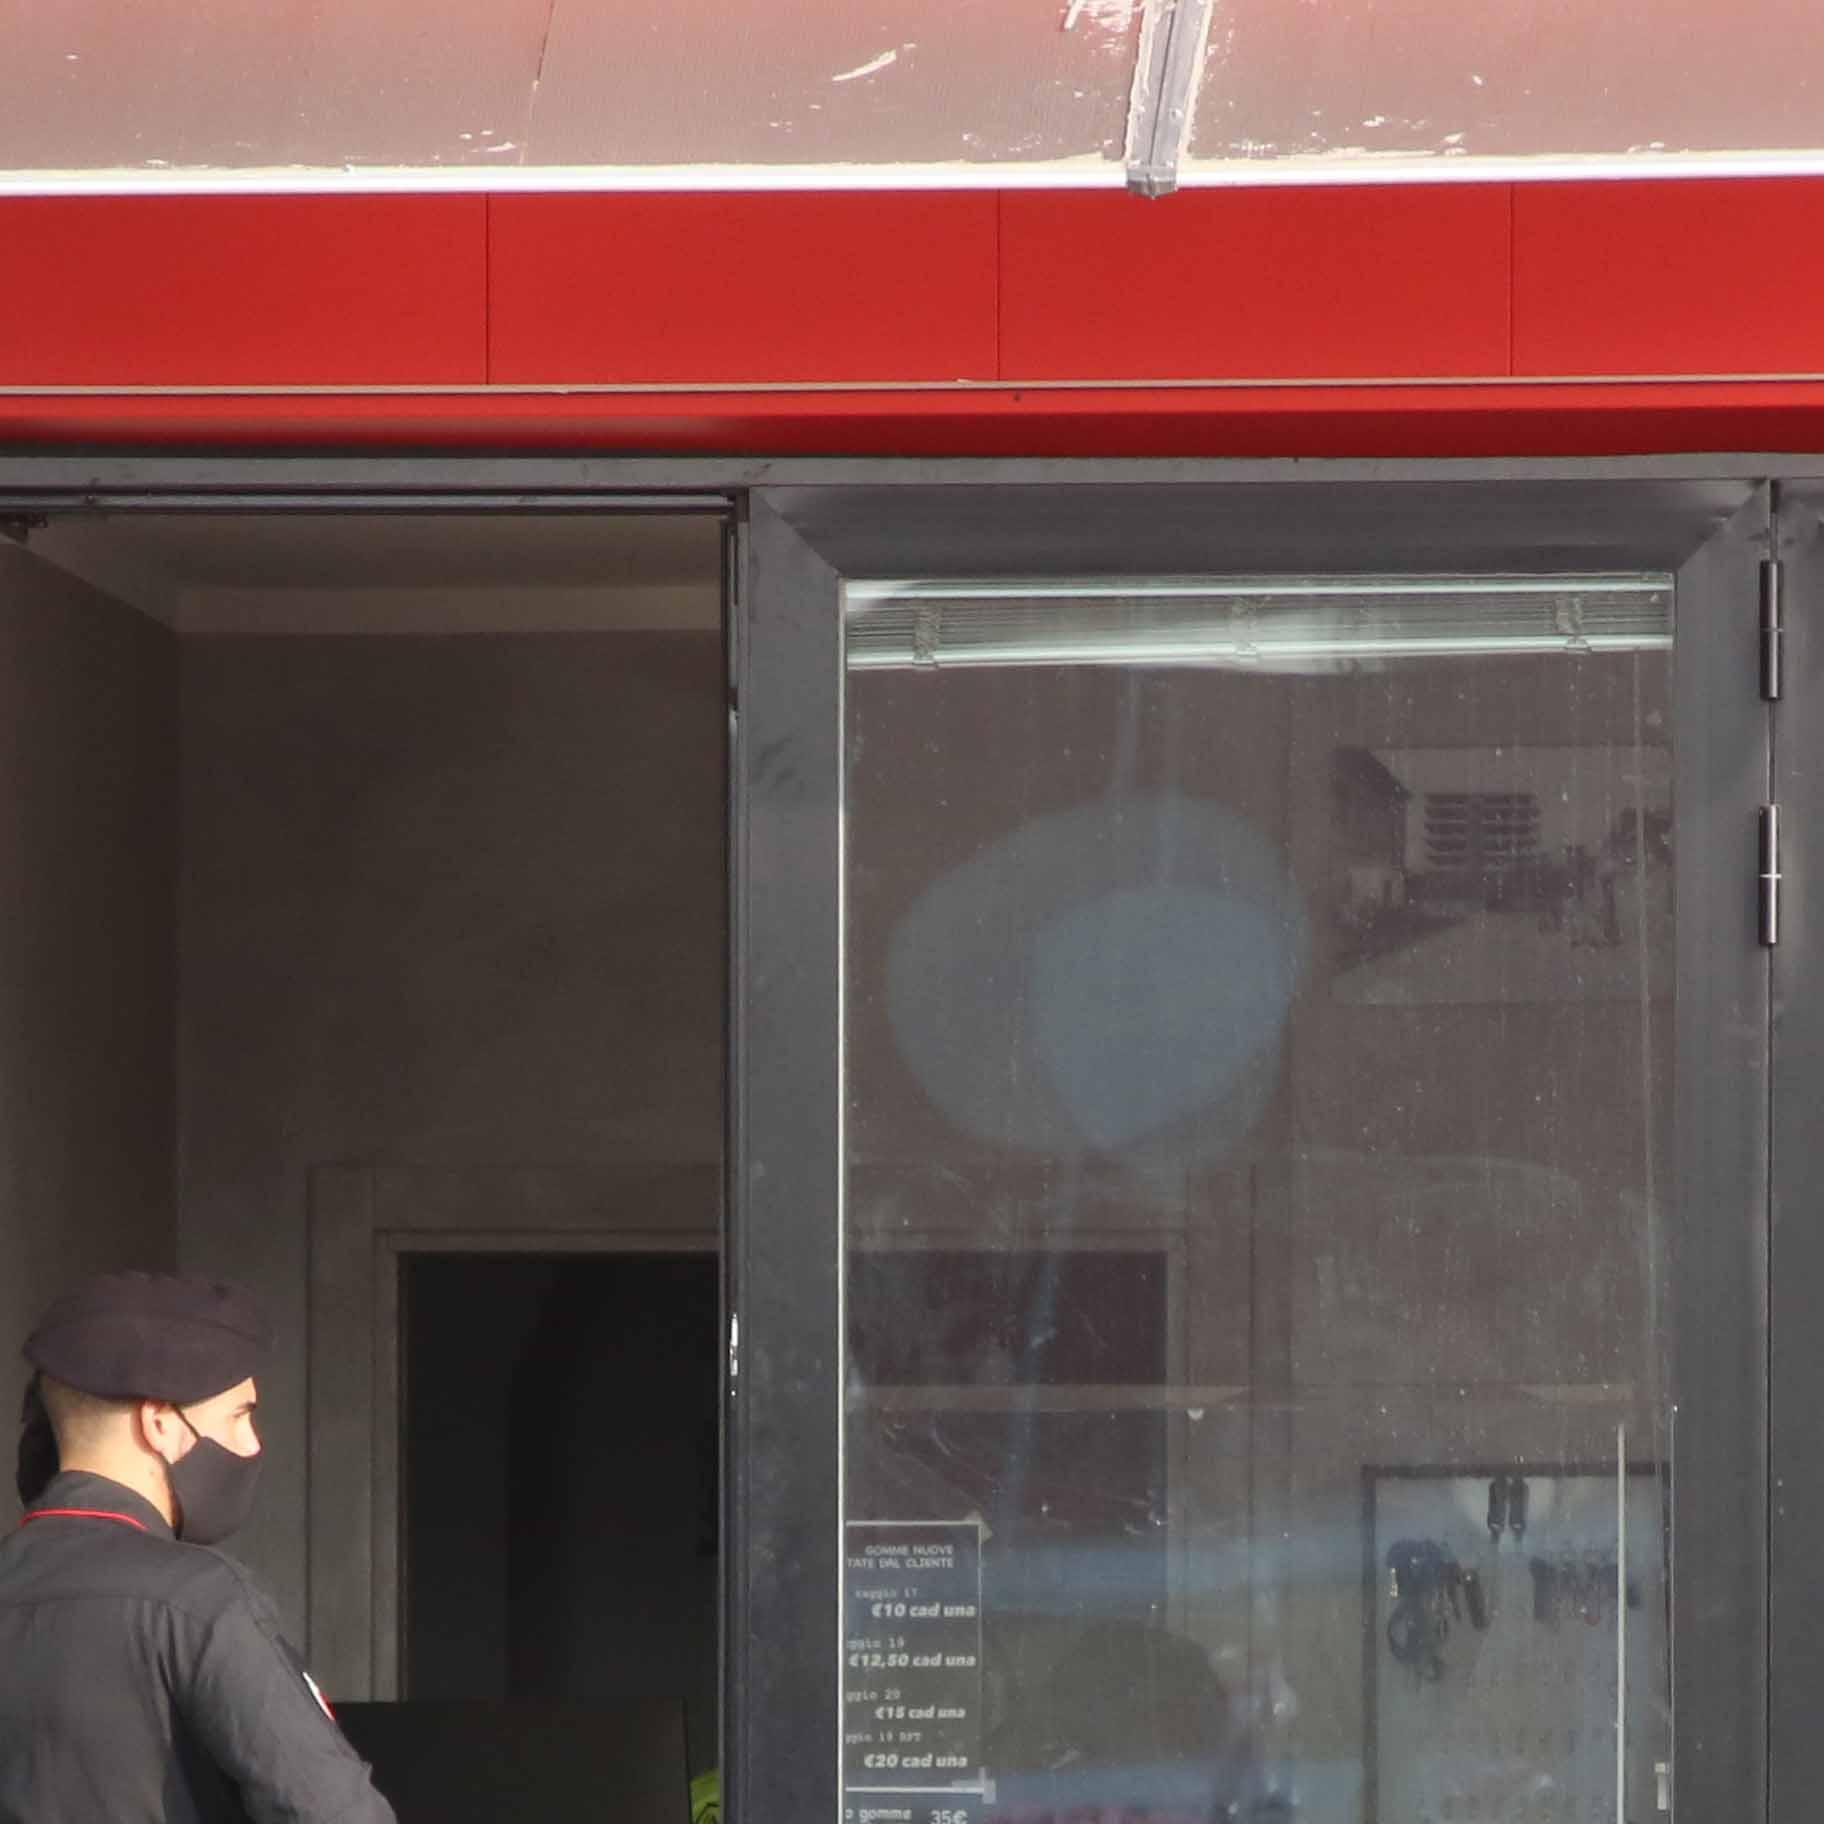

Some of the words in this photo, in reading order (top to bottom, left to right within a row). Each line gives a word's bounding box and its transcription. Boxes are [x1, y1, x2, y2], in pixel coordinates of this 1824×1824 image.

[909, 1602, 941, 1617] cad
[943, 1605, 976, 1617] una
[912, 1652, 943, 1667] cad
[945, 1656, 977, 1667] una
[908, 1705, 935, 1719] cad
[937, 1708, 967, 1719] una
[864, 1752, 899, 1768] €20
[901, 1752, 933, 1768] cad
[935, 1756, 968, 1768] una
